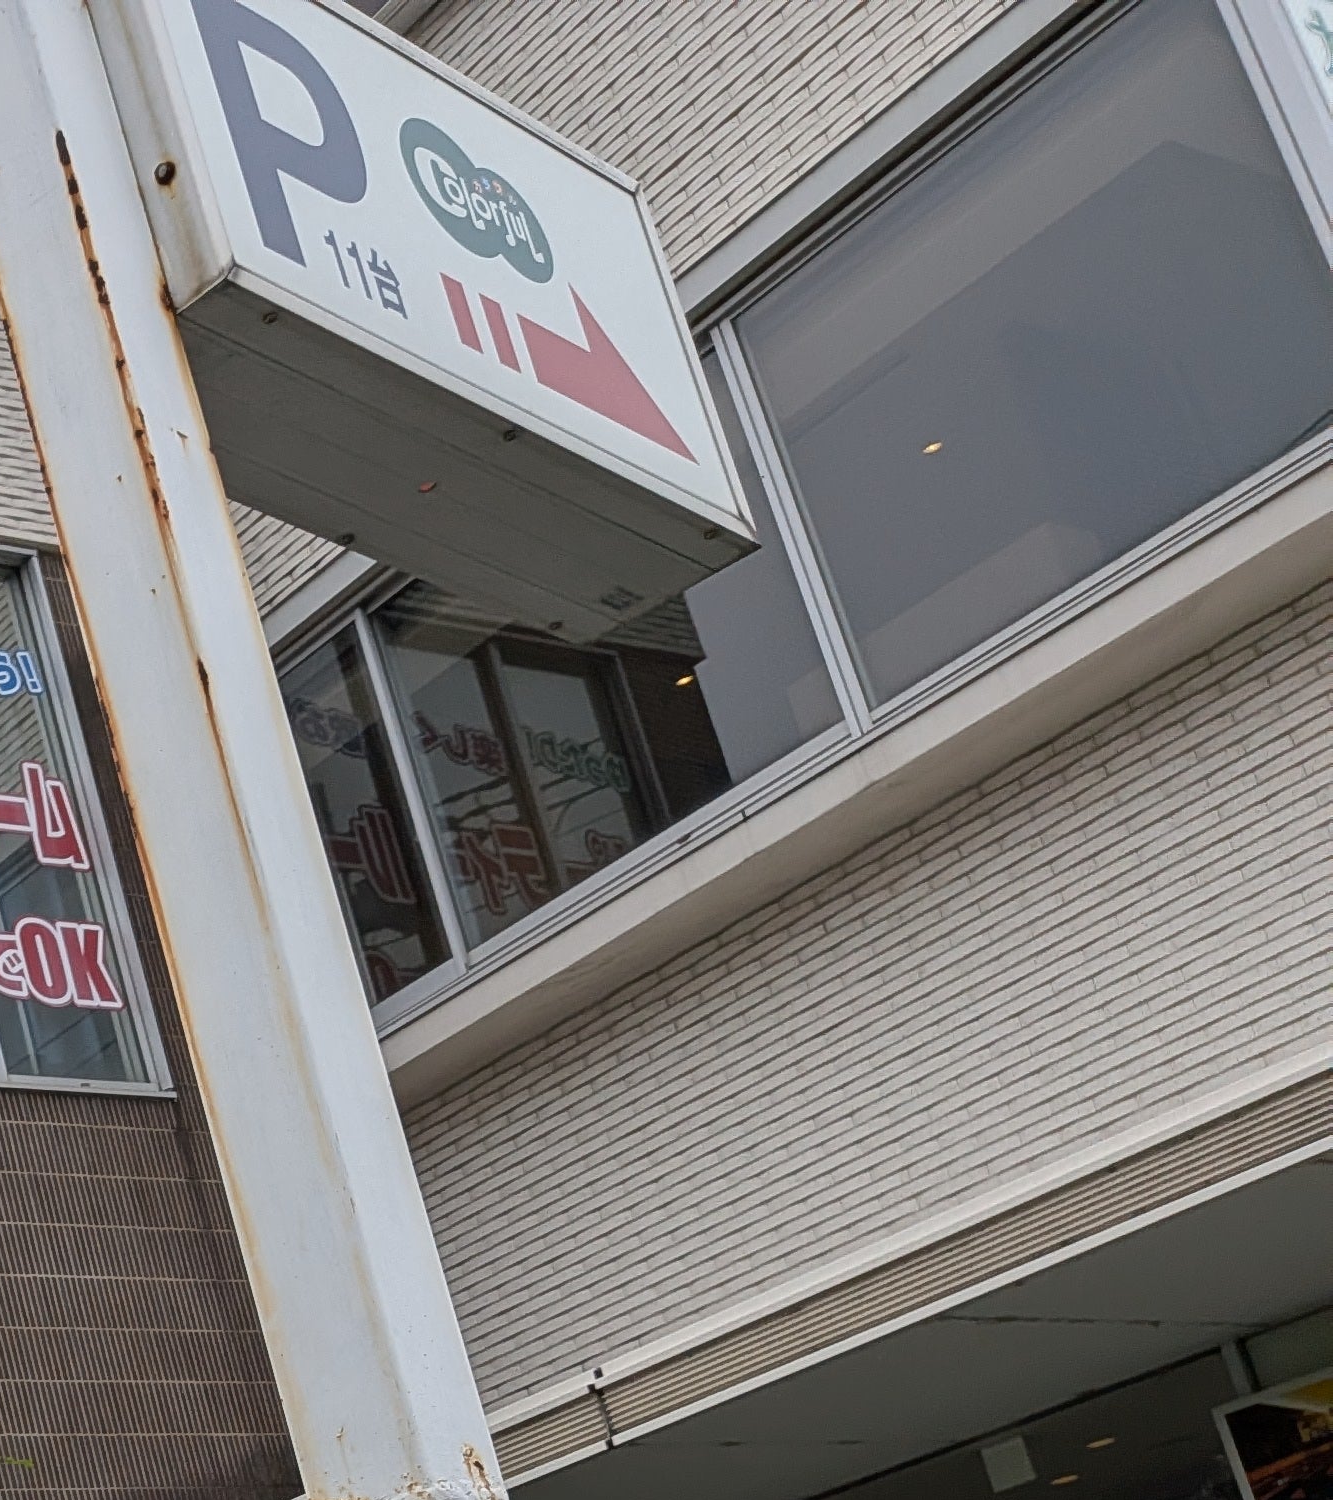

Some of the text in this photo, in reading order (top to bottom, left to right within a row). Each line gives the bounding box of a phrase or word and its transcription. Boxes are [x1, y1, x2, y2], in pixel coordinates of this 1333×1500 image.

[191, 0, 367, 268] P
[414, 147, 545, 264] Colorful
[324, 229, 408, 320] 11台
